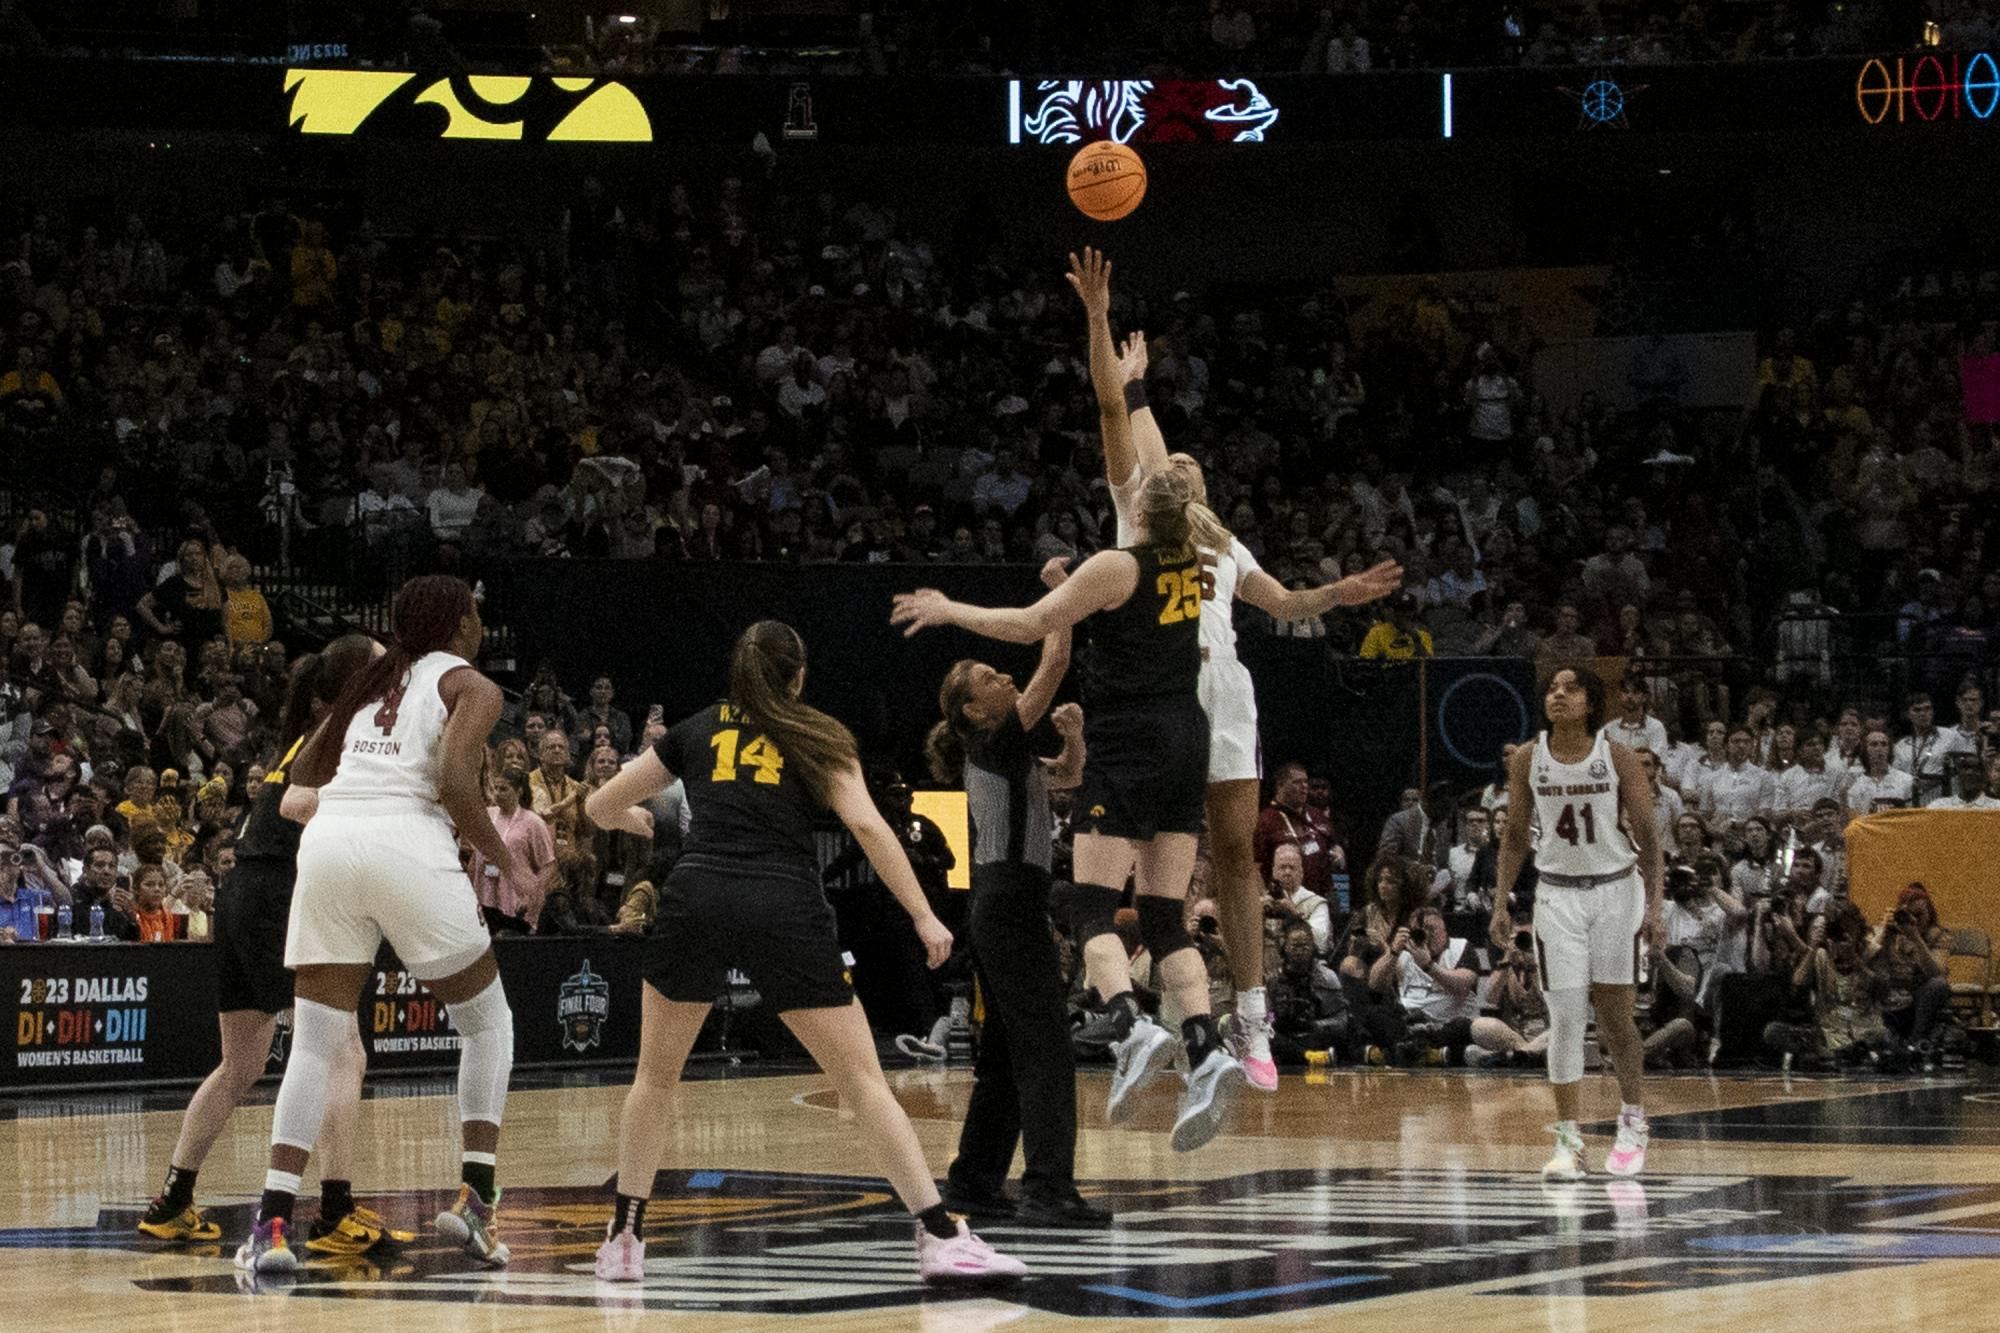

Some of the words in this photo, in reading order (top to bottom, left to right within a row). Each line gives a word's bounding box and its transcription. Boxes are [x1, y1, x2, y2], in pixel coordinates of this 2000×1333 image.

[1156, 567, 1200, 625] 25
[373, 690, 399, 736] 4
[352, 740, 402, 756] BOSTON
[709, 729, 784, 785] 14
[1556, 802, 1596, 846] 41
[20, 976, 69, 1004] 2023
[74, 976, 148, 1003] DALLAS
[560, 995, 582, 1018] FINAL
[585, 994, 606, 1015] FOUR
[105, 1007, 147, 1042] DIII
[17, 1050, 72, 1067] WOMEN'S
[72, 1048, 144, 1065] BASKETBALL
[373, 1036, 419, 1053] WOMEN'S
